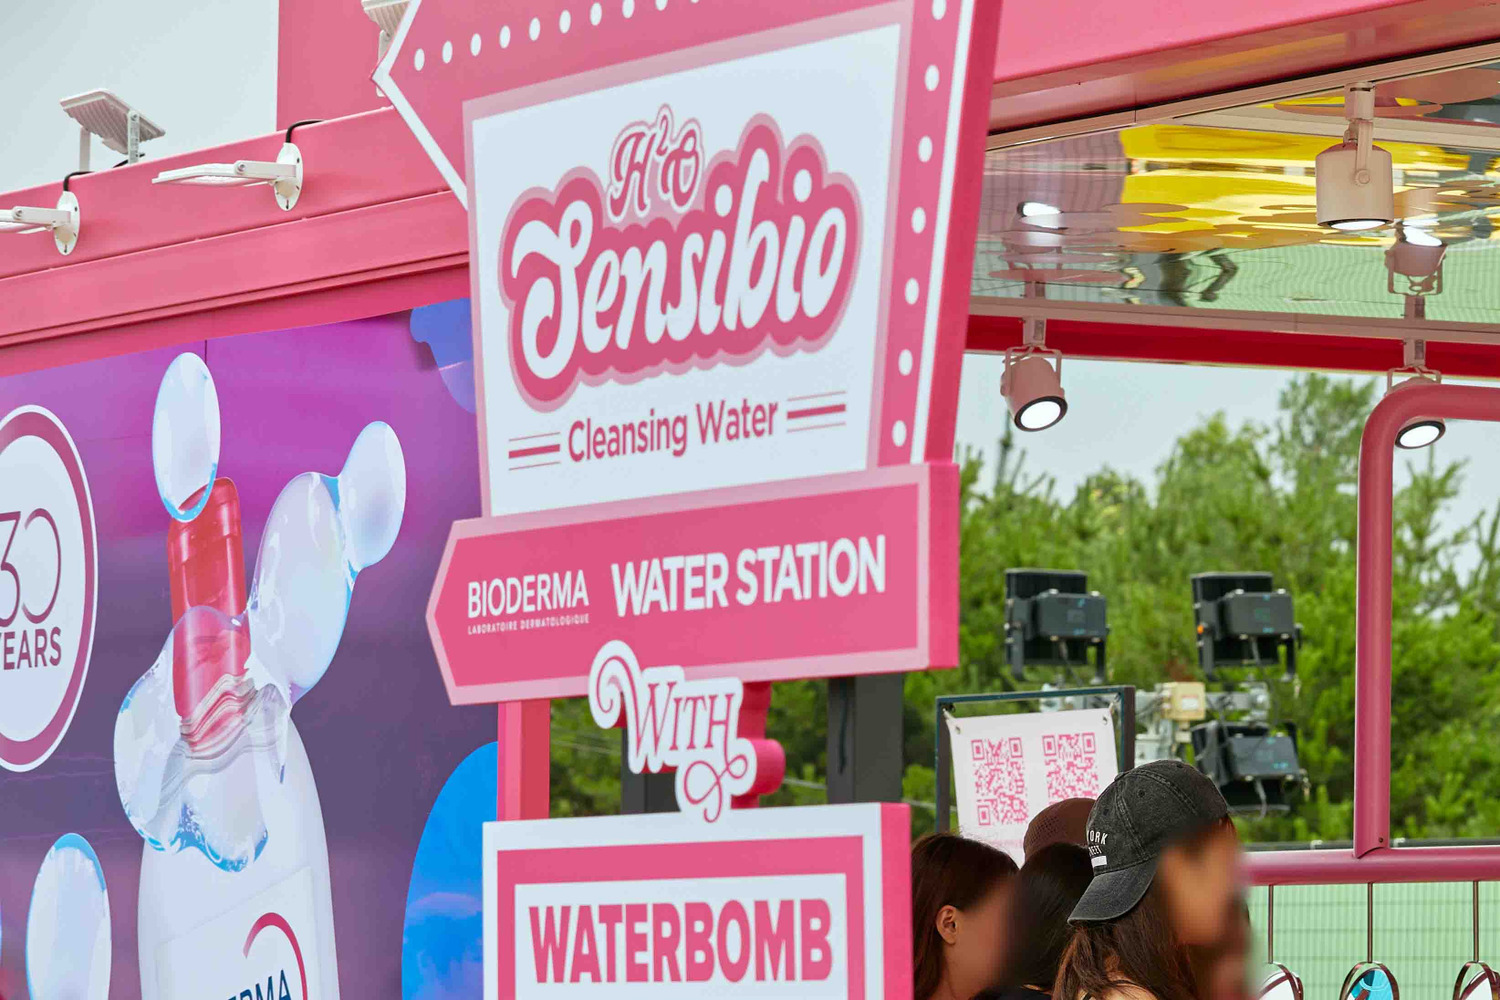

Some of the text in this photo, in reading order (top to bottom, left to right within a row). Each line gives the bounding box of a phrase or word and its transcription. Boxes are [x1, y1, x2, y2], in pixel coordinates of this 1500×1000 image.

[511, 147, 847, 379] Sensibio
[568, 398, 778, 465] Cleansing Water
[468, 534, 887, 618] BIODERMA WATER STATION
[0, 626, 61, 670] EARS
[468, 613, 590, 635] LABORATOIRE DERMATOLOGIQUE
[1086, 830, 1108, 845] ORK
[529, 898, 833, 984] WATERBOMB
